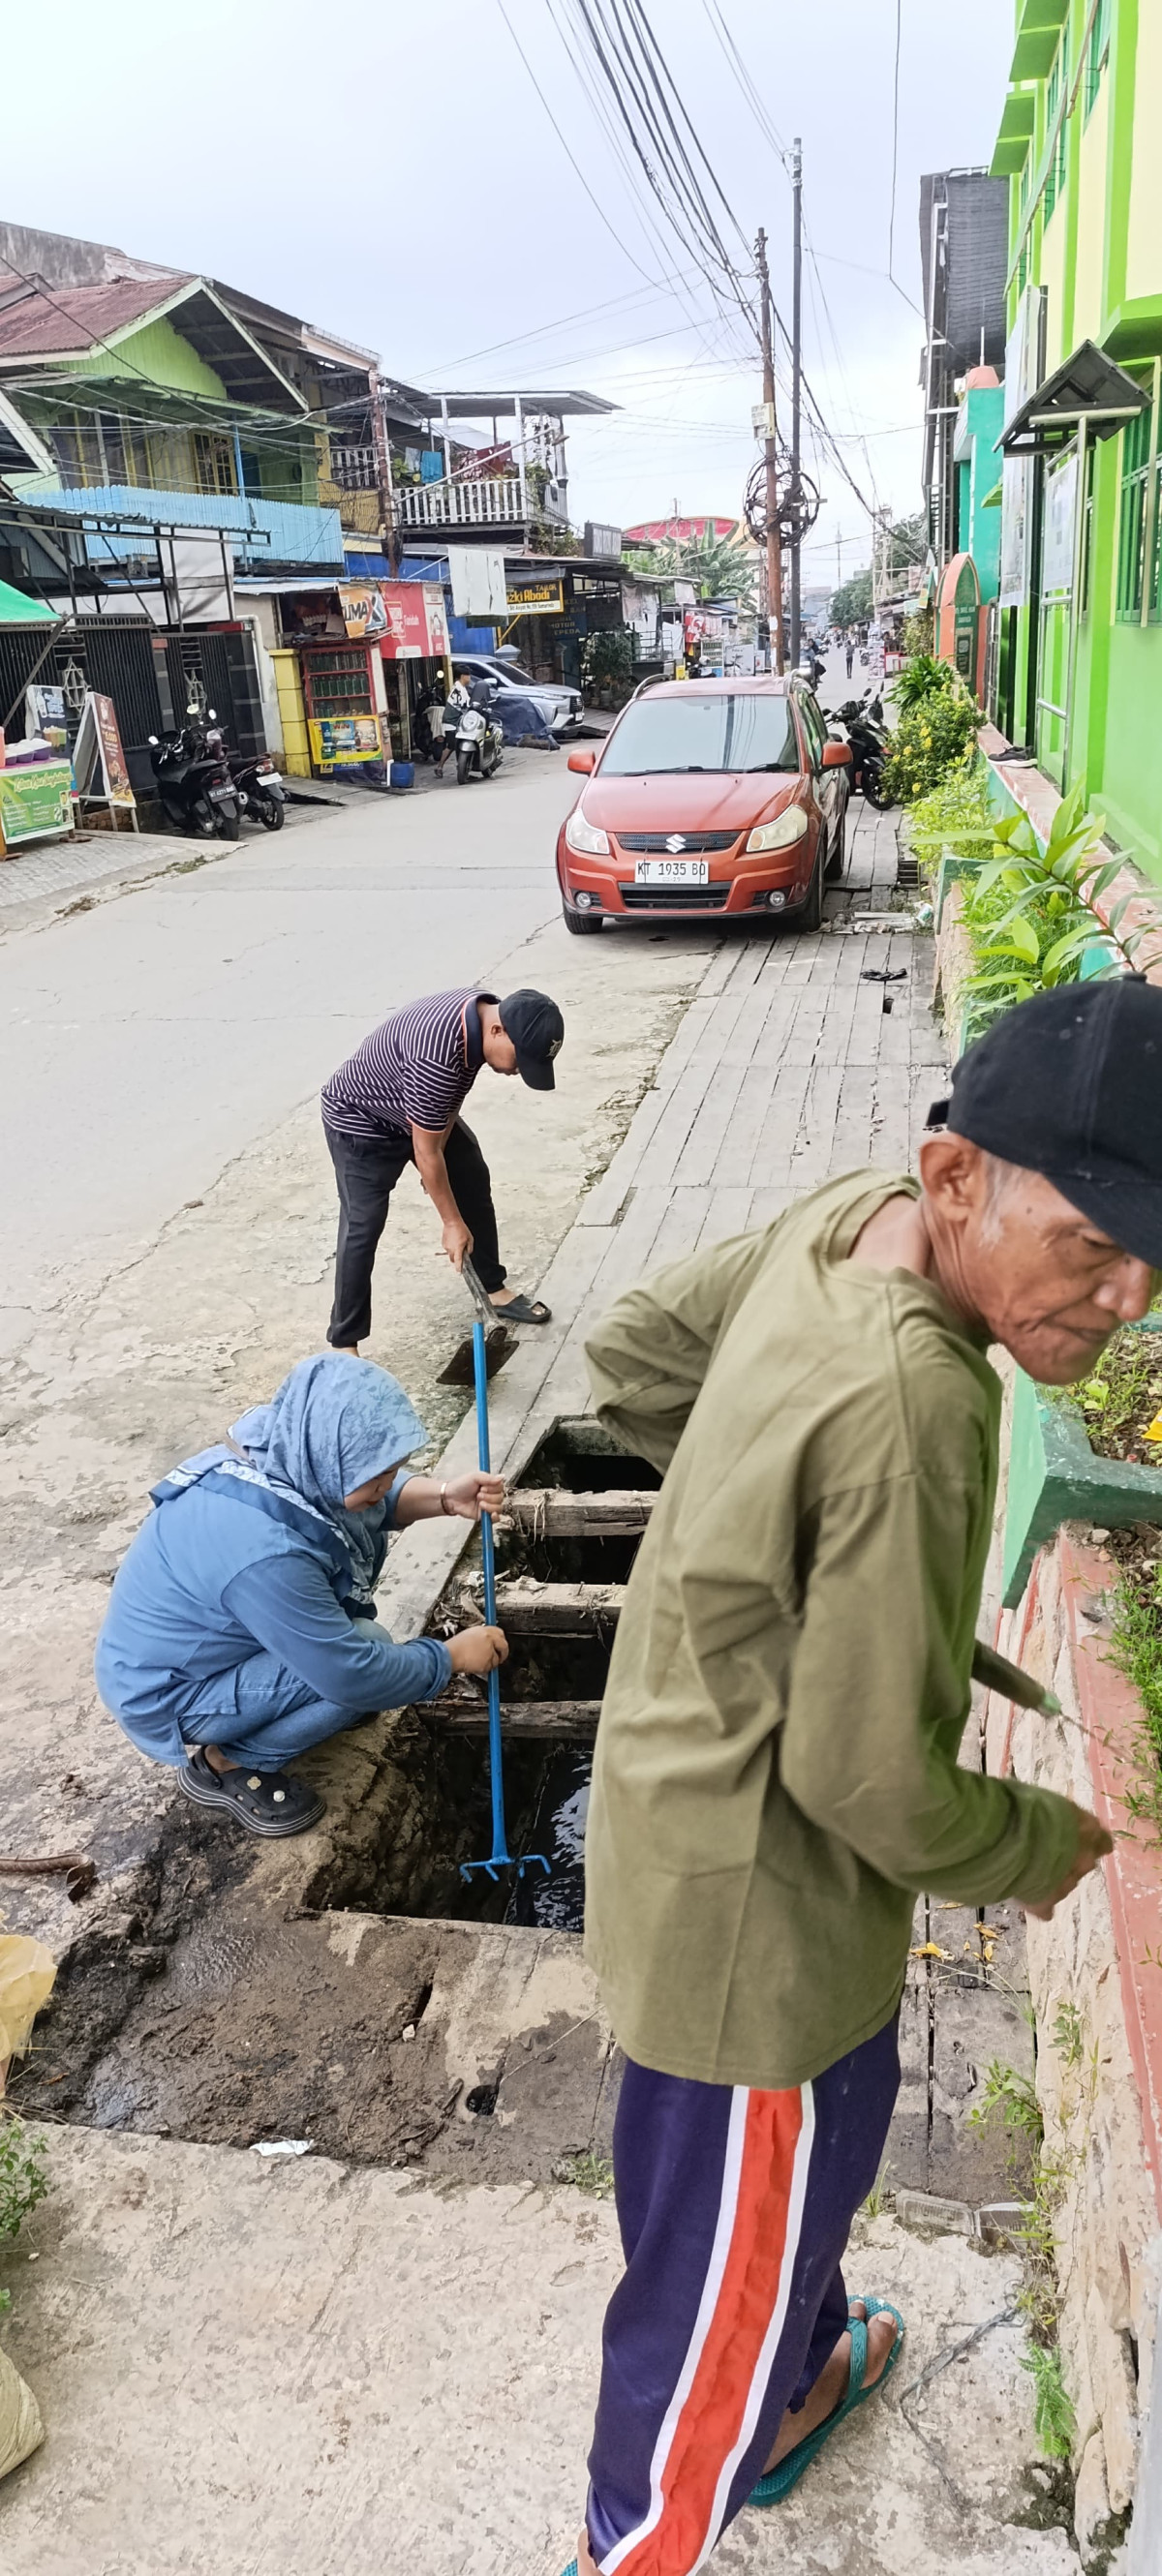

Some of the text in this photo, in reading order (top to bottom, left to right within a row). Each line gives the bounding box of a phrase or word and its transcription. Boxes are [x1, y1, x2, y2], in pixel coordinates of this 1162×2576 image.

[524, 589, 550, 601] Abadi
[637, 863, 651, 875] KT
[658, 863, 687, 875] 1935
